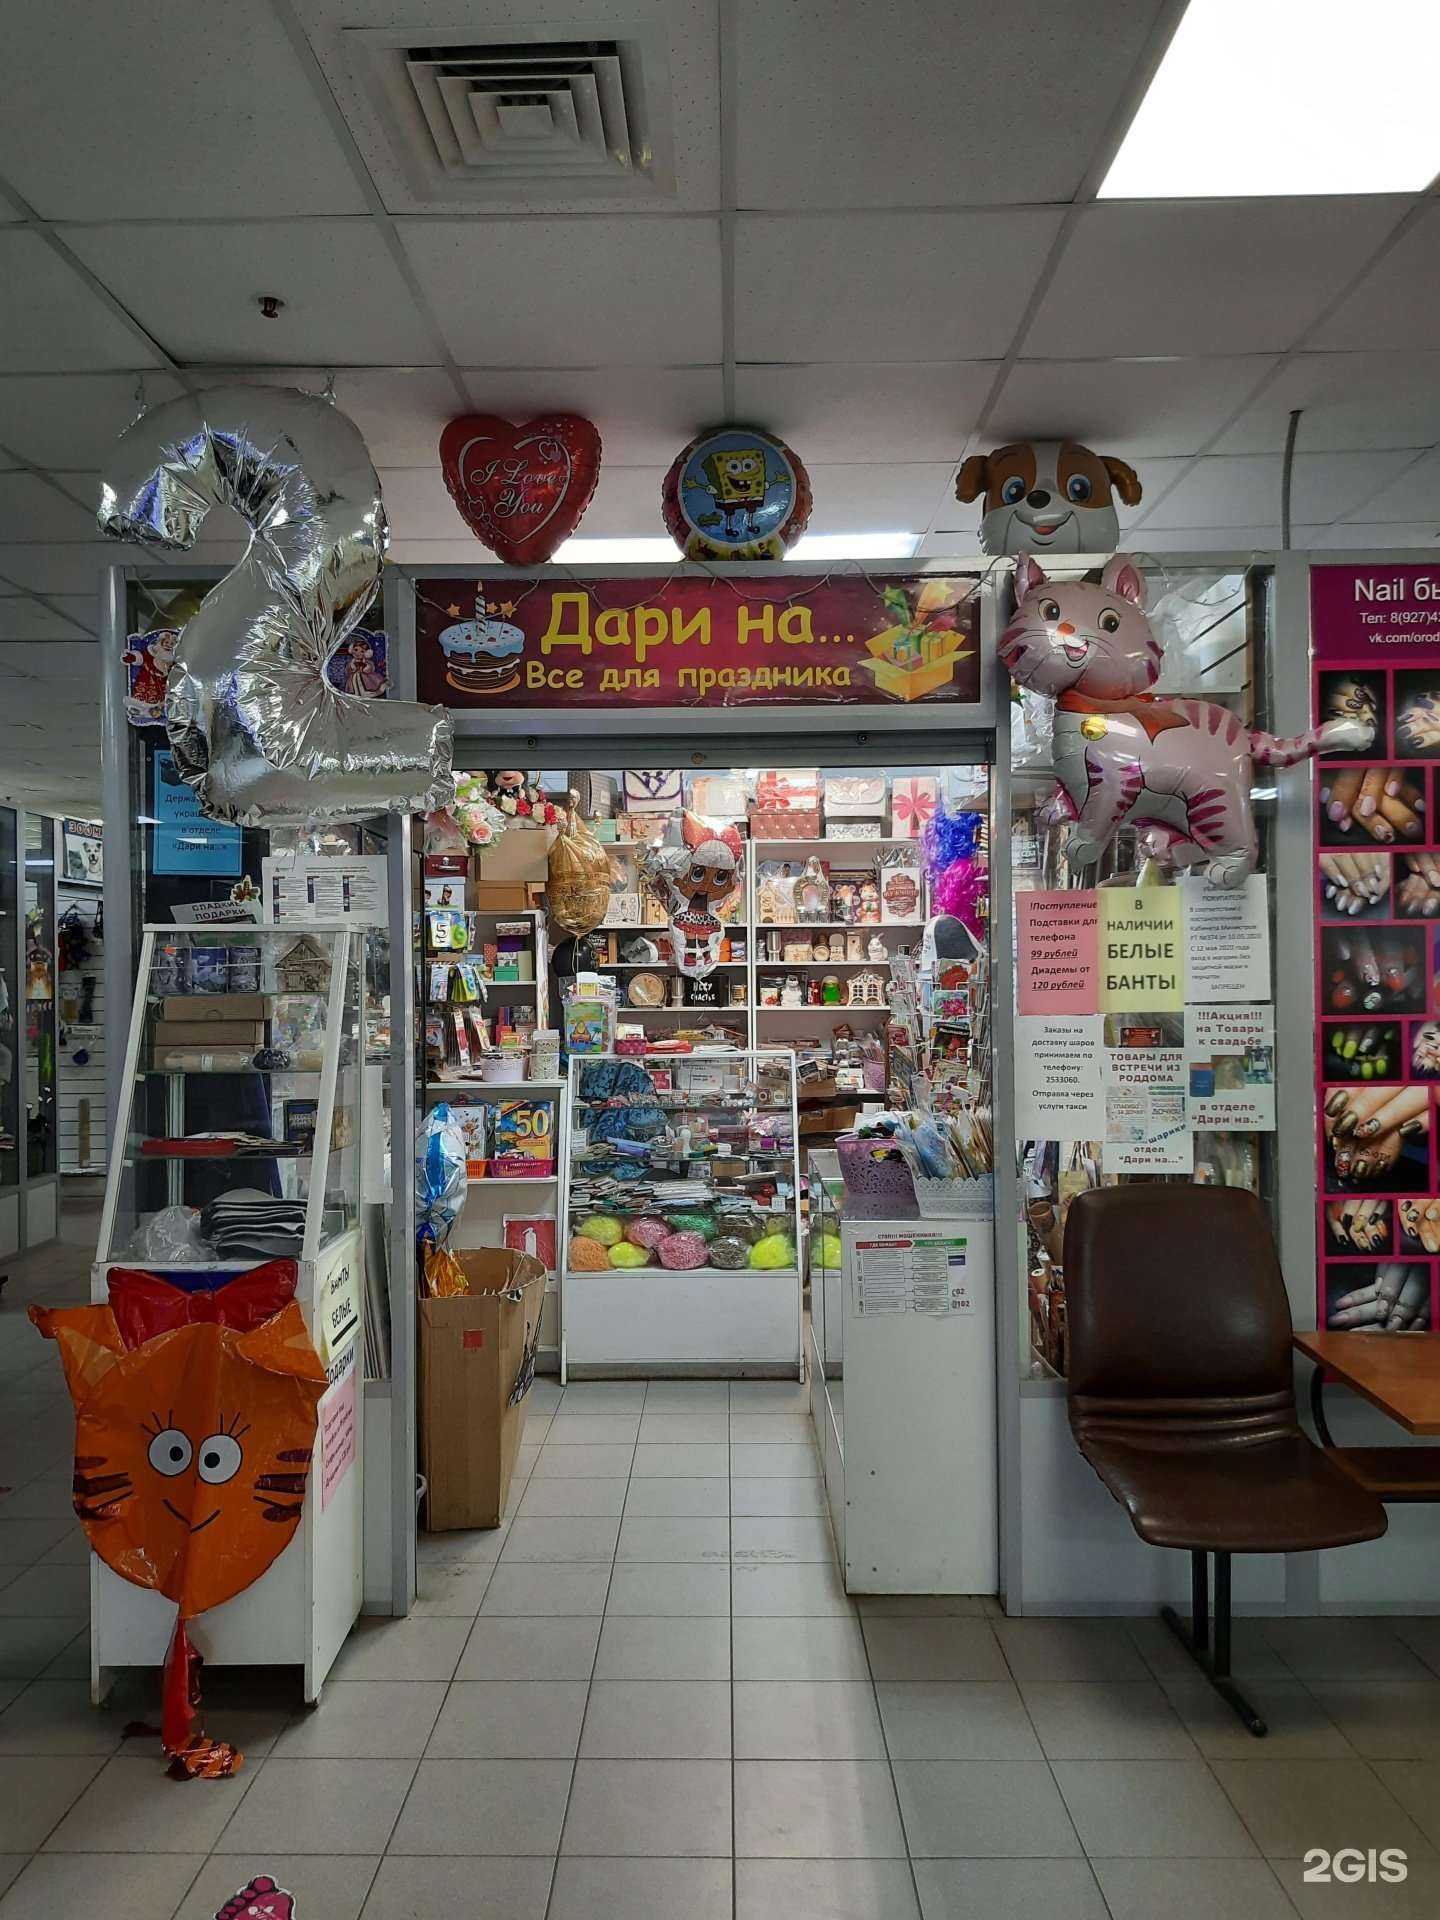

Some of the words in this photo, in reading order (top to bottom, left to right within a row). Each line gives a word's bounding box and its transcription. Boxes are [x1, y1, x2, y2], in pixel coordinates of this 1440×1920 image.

[501, 458, 557, 485] Love
[493, 487, 545, 518] You
[1354, 578, 1404, 601] Nail
[540, 592, 711, 662] Дари
[737, 604, 855, 644] на...
[526, 661, 584, 689] Все
[599, 665, 660, 689] для
[678, 664, 852, 696] праздника
[1135, 900, 1143, 910] В
[195, 909, 247, 921] ПОДАРКИ
[1030, 919, 1080, 927] Подставки
[1107, 919, 1173, 931] НАЛИЧИИ
[435, 923, 447, 938] 5
[1030, 933, 1076, 942] телефона
[1031, 950, 1043, 959] 99
[1044, 948, 1079, 959] рублей
[1107, 943, 1174, 959] БЕЛЫЕ
[1032, 966, 1077, 975] Диадемы
[1032, 981, 1049, 990] 120
[1050, 980, 1085, 990] рублей
[1106, 974, 1175, 990] БАНТЫ
[1198, 1011, 1262, 1021] !!!Акция!!!
[1216, 1024, 1264, 1034] Товары
[1210, 1037, 1262, 1046] свадьбе
[1110, 1053, 1156, 1061] ТОВАРЫ
[1160, 1053, 1183, 1062] ДЛЯ
[1043, 1064, 1084, 1072] телефону:
[1112, 1064, 1163, 1072] ВСТРЕЧИ
[1119, 1074, 1174, 1082] РОДДОМА
[1032, 1090, 1069, 1098] Отправка
[516, 1109, 549, 1137] 50
[1148, 1123, 1187, 1143] шарики
[332, 1297, 351, 1328] БЕЛЫЕ
